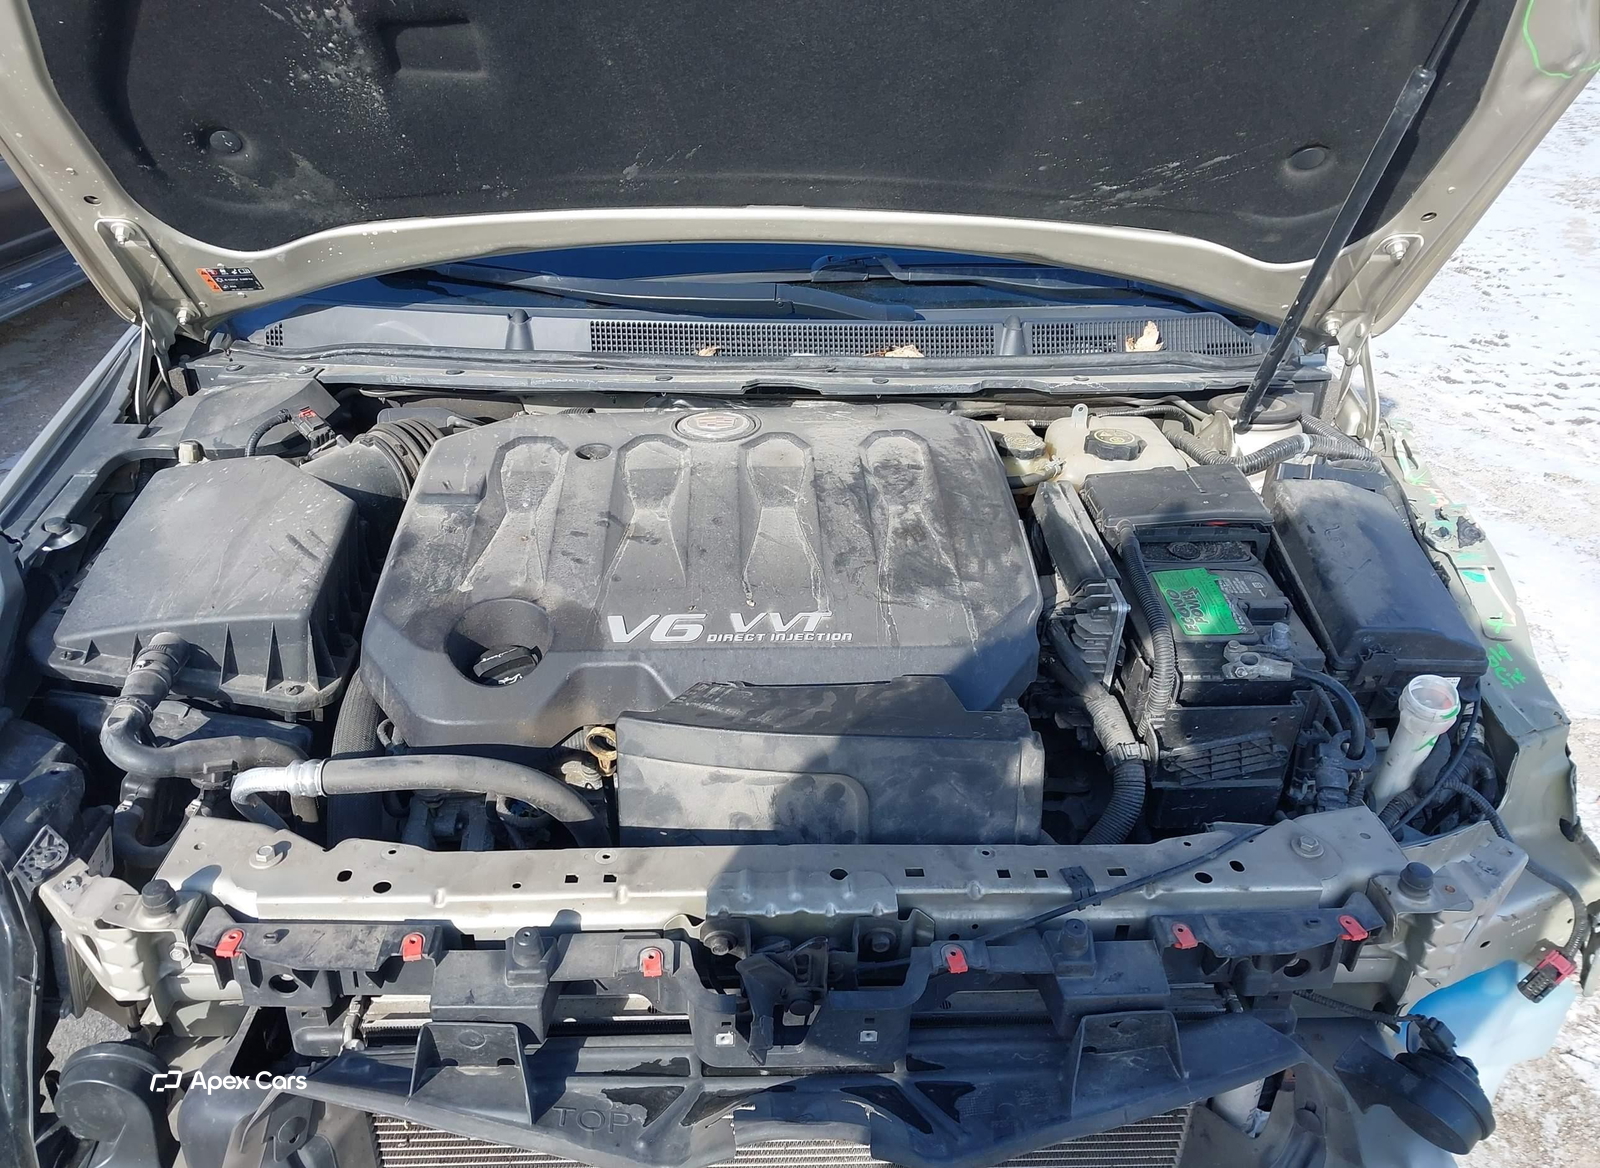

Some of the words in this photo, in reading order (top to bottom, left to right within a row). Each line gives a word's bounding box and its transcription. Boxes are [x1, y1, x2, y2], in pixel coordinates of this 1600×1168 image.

[1166, 588, 1201, 633] ECONO
[1182, 586, 1209, 625] POWER
[607, 613, 708, 644] V6
[730, 610, 833, 633] VVT
[706, 633, 766, 643] DIRECT
[770, 631, 853, 642] INJECTION
[552, 1105, 633, 1134] TOP
